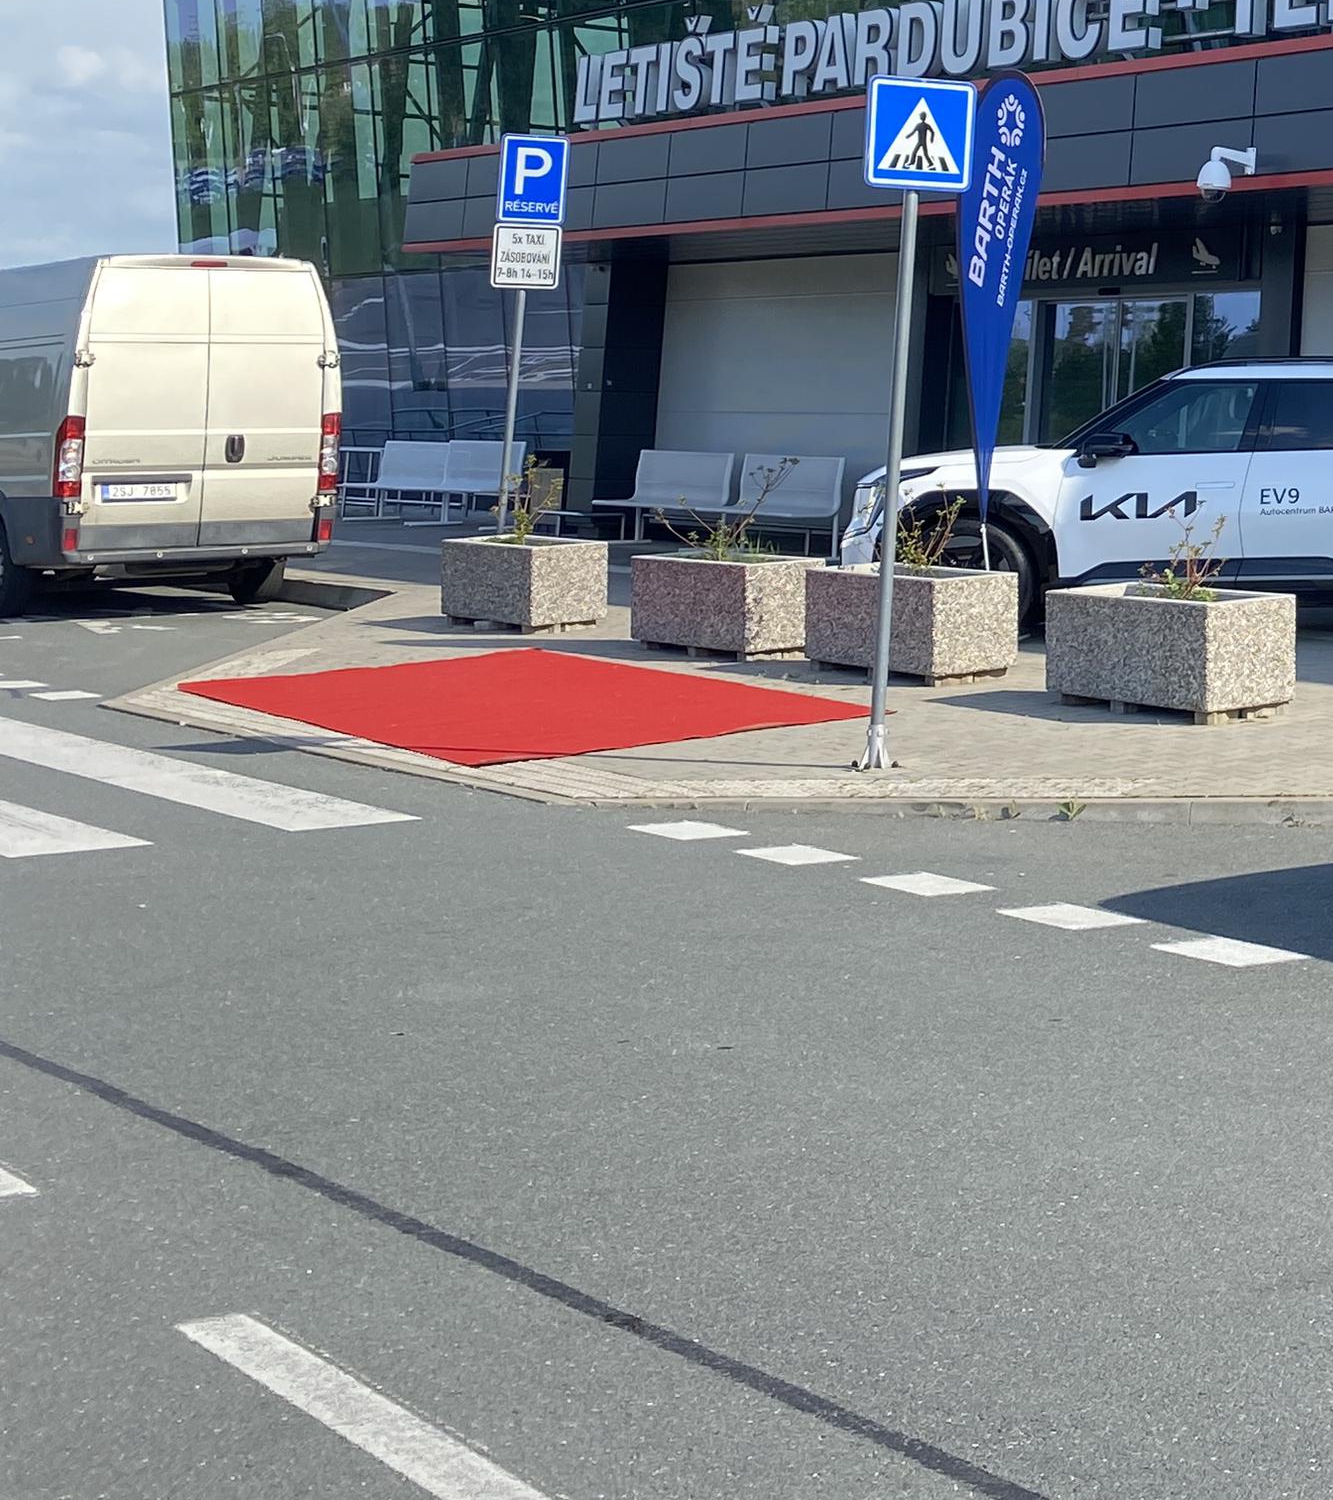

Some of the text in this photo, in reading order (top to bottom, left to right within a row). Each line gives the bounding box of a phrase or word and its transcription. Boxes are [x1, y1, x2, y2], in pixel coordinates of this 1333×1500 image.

[574, 3, 779, 123] LETIŠTĚ
[514, 147, 553, 195] P
[505, 200, 558, 213] RÉSERVÉ
[968, 146, 1006, 288] BARTH
[994, 157, 1018, 240] OPERÁK
[512, 233, 545, 245] 5x TAXI
[1024, 248, 1061, 280] ílet
[1076, 242, 1158, 278] Arrival
[1260, 488, 1300, 505] EV9
[1260, 507, 1317, 517] Autocentrum
